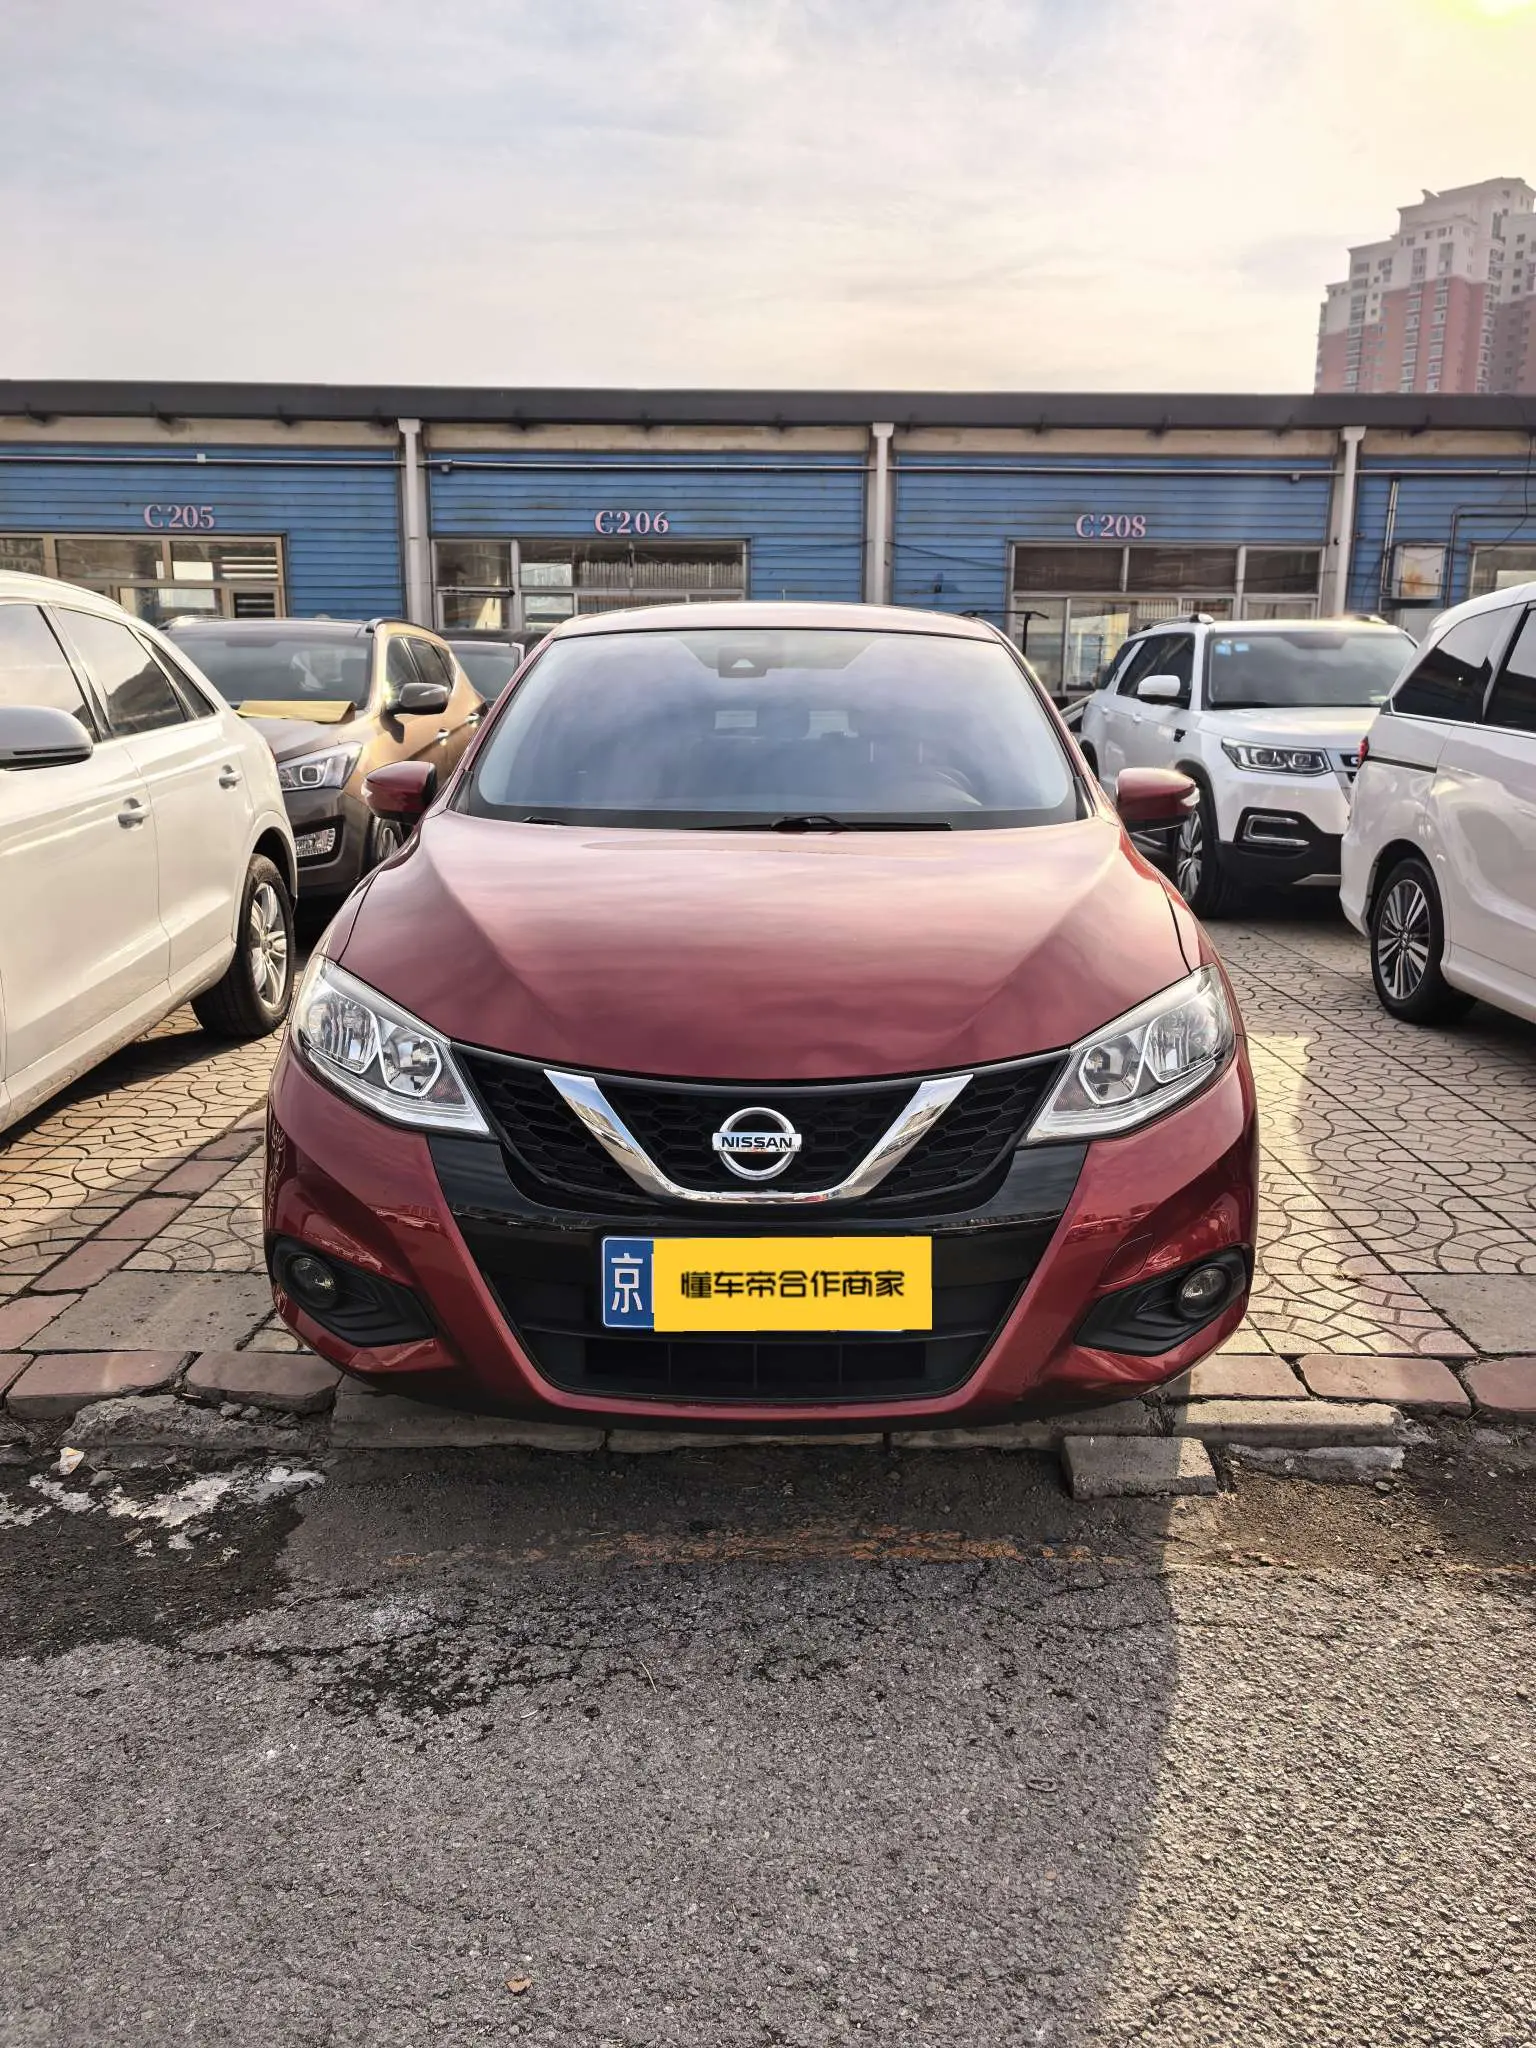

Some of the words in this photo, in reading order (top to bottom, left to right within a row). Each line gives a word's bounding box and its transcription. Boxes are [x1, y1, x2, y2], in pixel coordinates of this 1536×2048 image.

[595, 510, 669, 534] C206
[721, 1136, 793, 1149] NISSAN
[610, 1252, 654, 1314] 京
